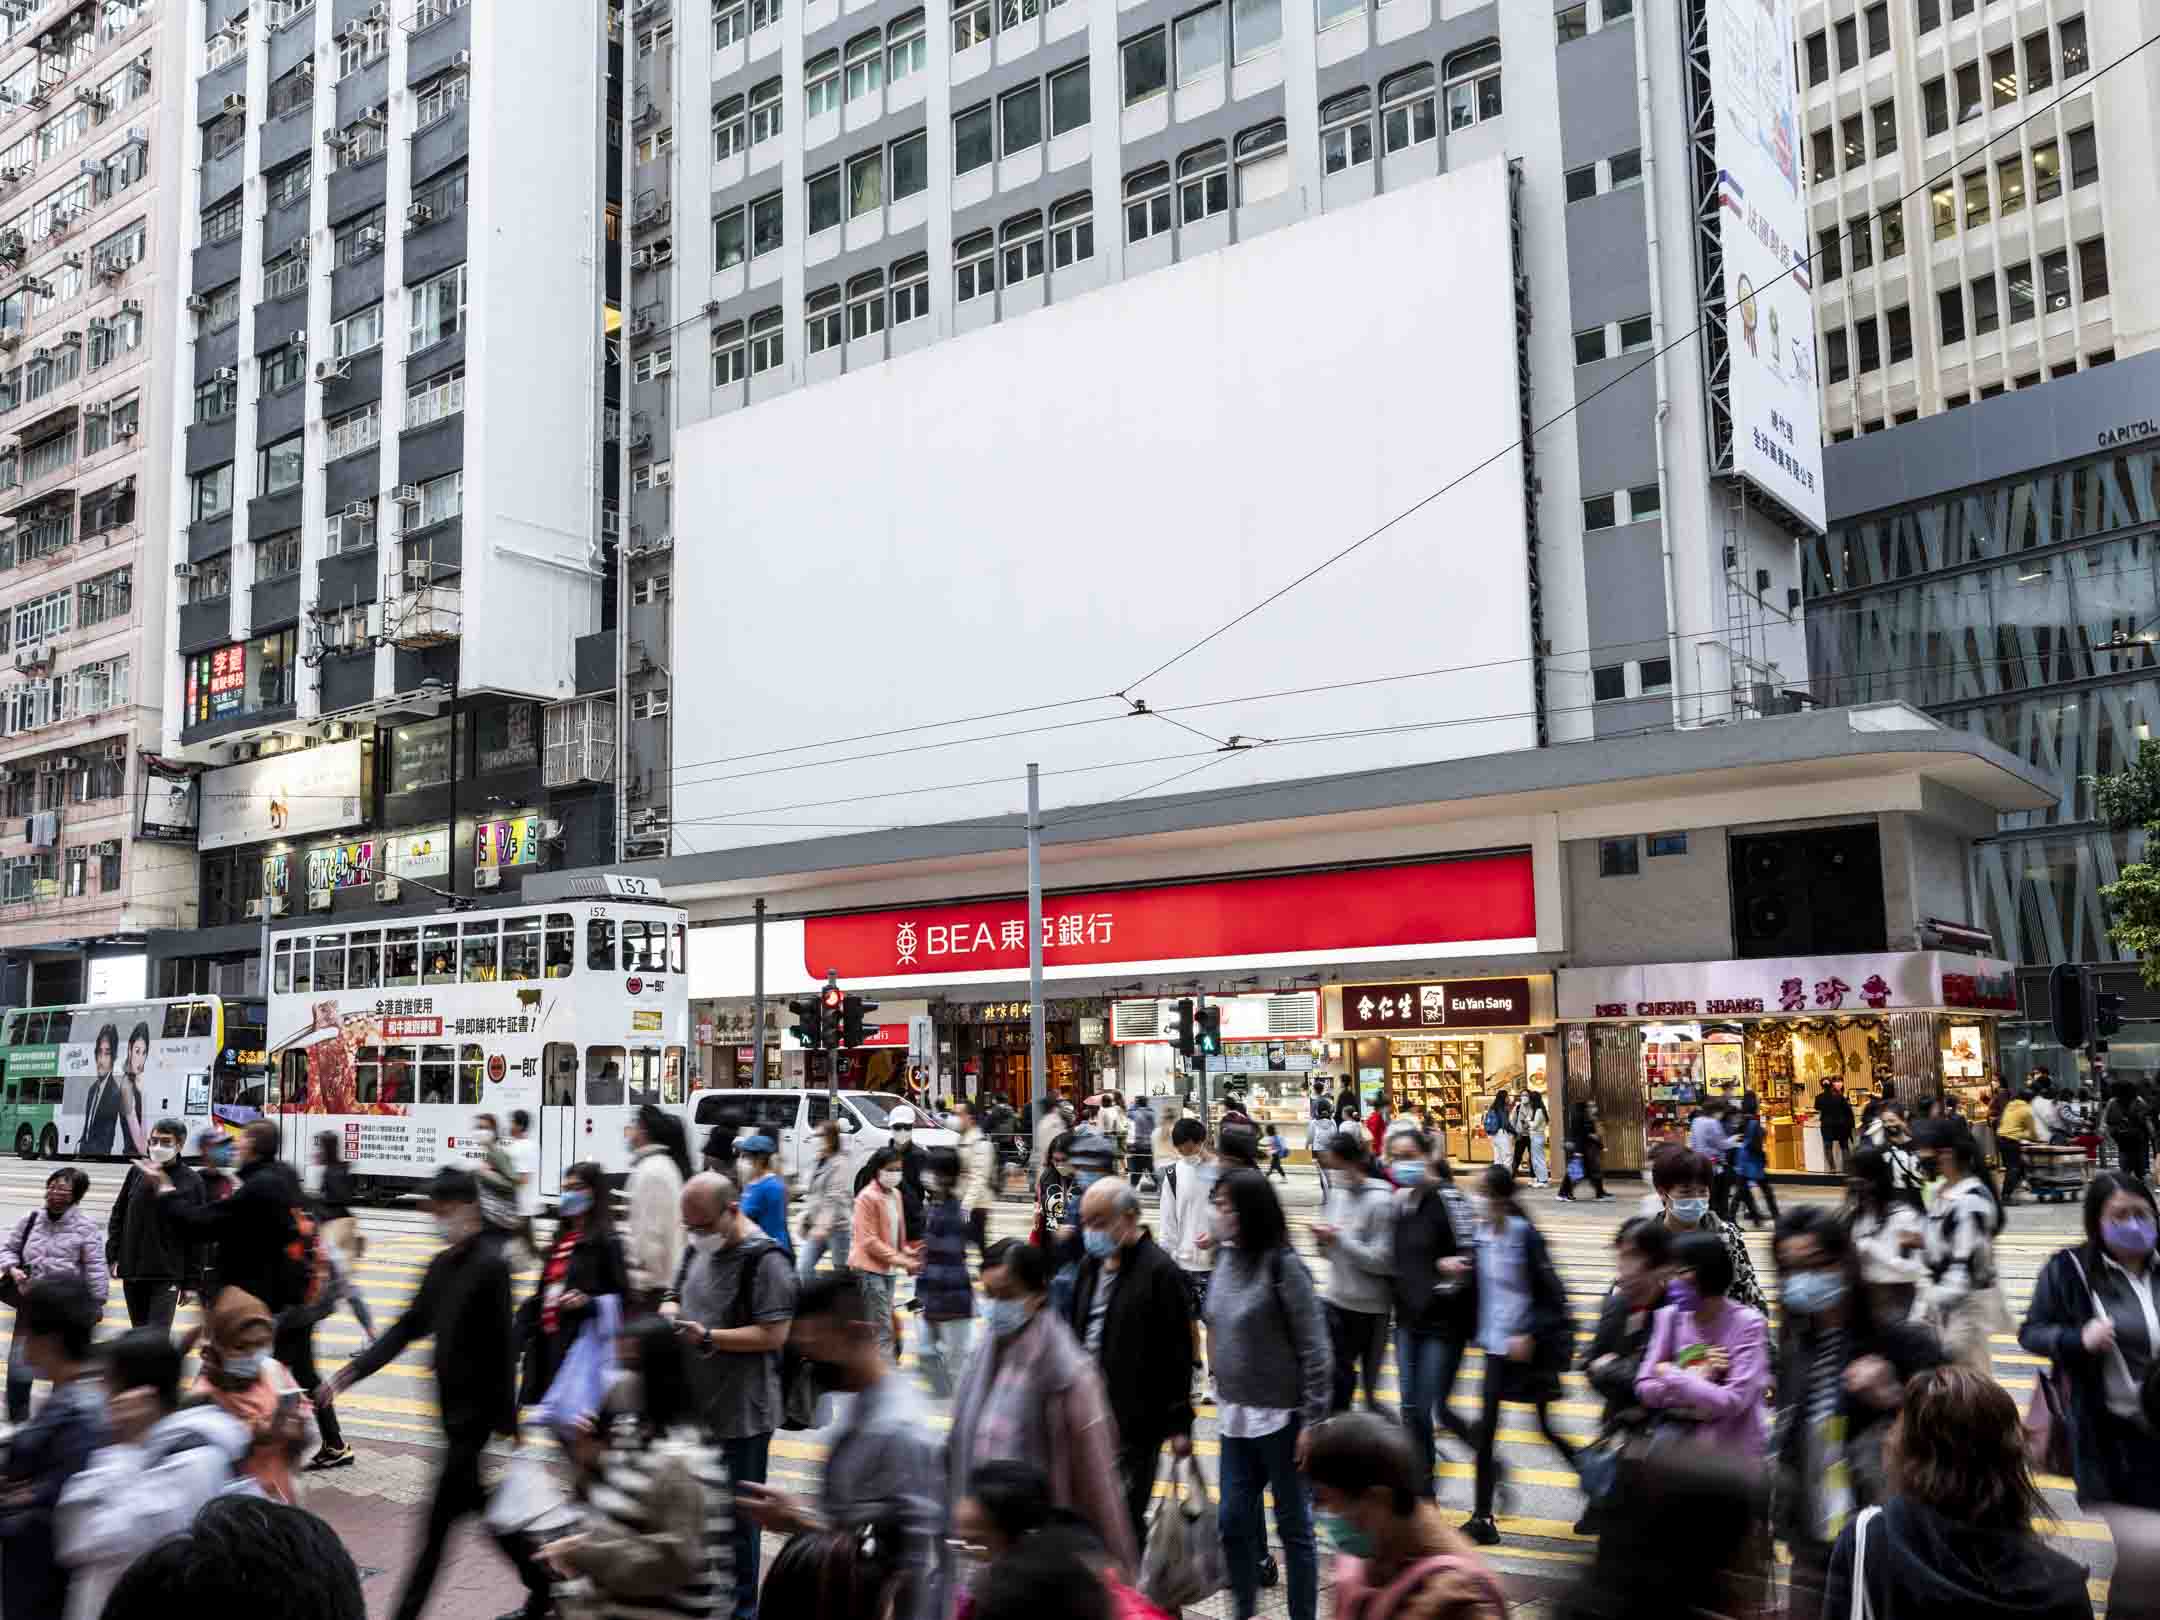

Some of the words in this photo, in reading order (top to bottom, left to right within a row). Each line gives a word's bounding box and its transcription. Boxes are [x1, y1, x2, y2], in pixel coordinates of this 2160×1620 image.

[2098, 418, 2159, 446] CAPITOL
[617, 878, 649, 896] 152
[590, 907, 606, 917] 152
[927, 923, 996, 955] BEA
[646, 980, 664, 992] 一郎
[376, 998, 433, 1016] 全港首推使用
[1452, 999, 1465, 1010] Eu
[1466, 998, 1484, 1010] Yan
[1485, 997, 1512, 1011] Sang
[1595, 1003, 1628, 1016] BEE
[1637, 1000, 1697, 1015] CHENG
[1705, 998, 1764, 1014] HIANG
[510, 1056, 538, 1078] 一郎
